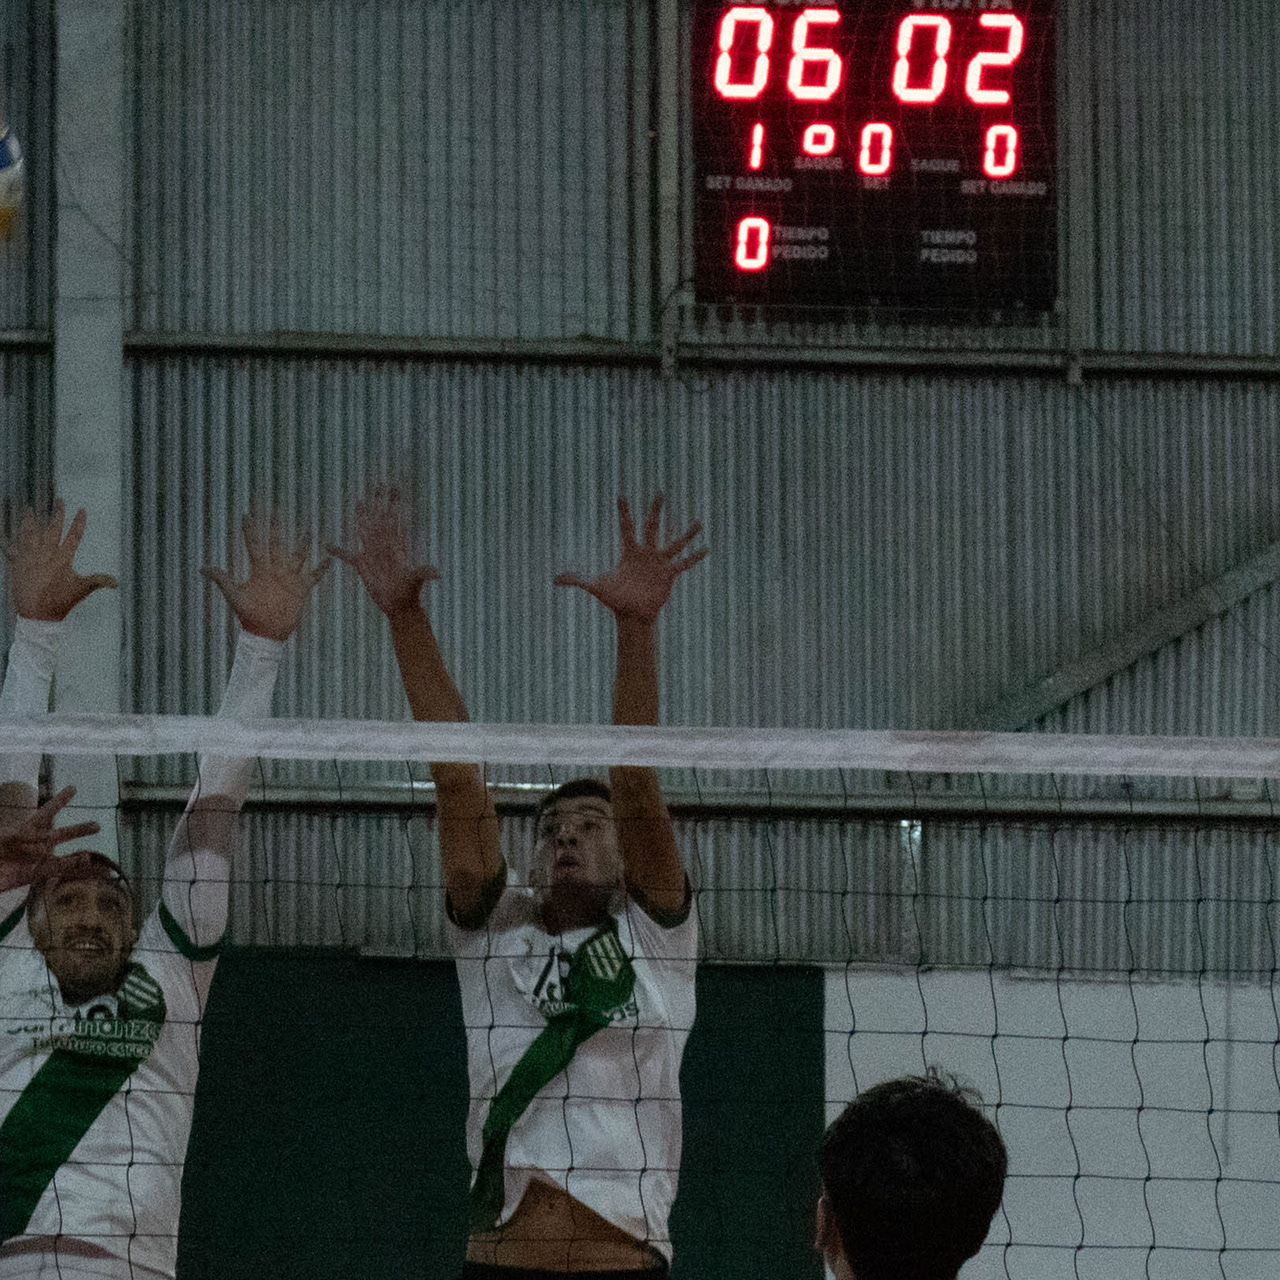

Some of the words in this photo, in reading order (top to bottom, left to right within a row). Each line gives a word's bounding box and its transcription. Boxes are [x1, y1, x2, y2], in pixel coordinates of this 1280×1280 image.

[715, 7, 842, 99] 06
[892, 14, 1024, 104] 02
[750, 123, 764, 169] 1
[984, 125, 1018, 177] 0
[736, 217, 770, 270] 0
